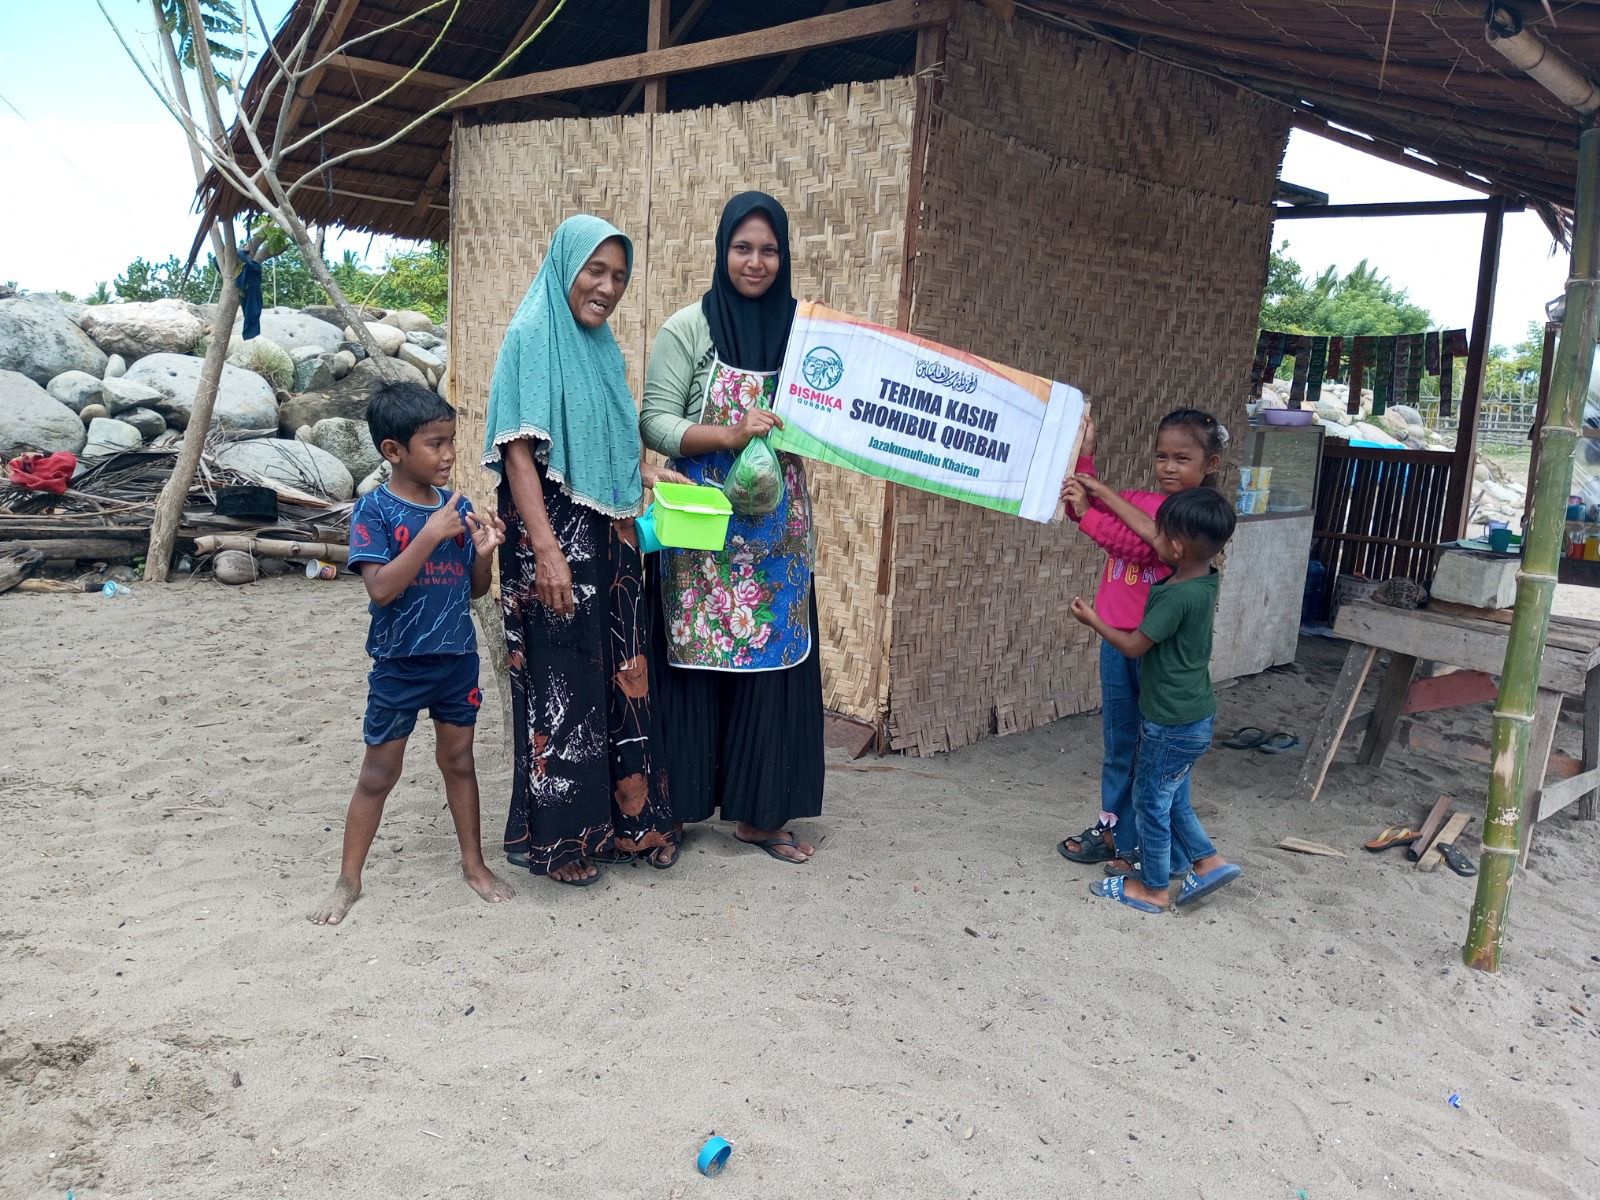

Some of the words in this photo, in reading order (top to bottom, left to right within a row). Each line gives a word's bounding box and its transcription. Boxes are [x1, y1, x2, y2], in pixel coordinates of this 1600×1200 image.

[789, 383, 842, 410] BISMIKA
[797, 397, 832, 413] QURBAN
[879, 378, 942, 417] TERIMA
[945, 399, 998, 432] KASIH
[850, 398, 937, 443] SHOHIBUL
[941, 425, 1010, 463] QURBAN
[868, 436, 941, 467] Jazakumullahu
[942, 457, 980, 478] Khairan
[425, 561, 464, 576] IHAD
